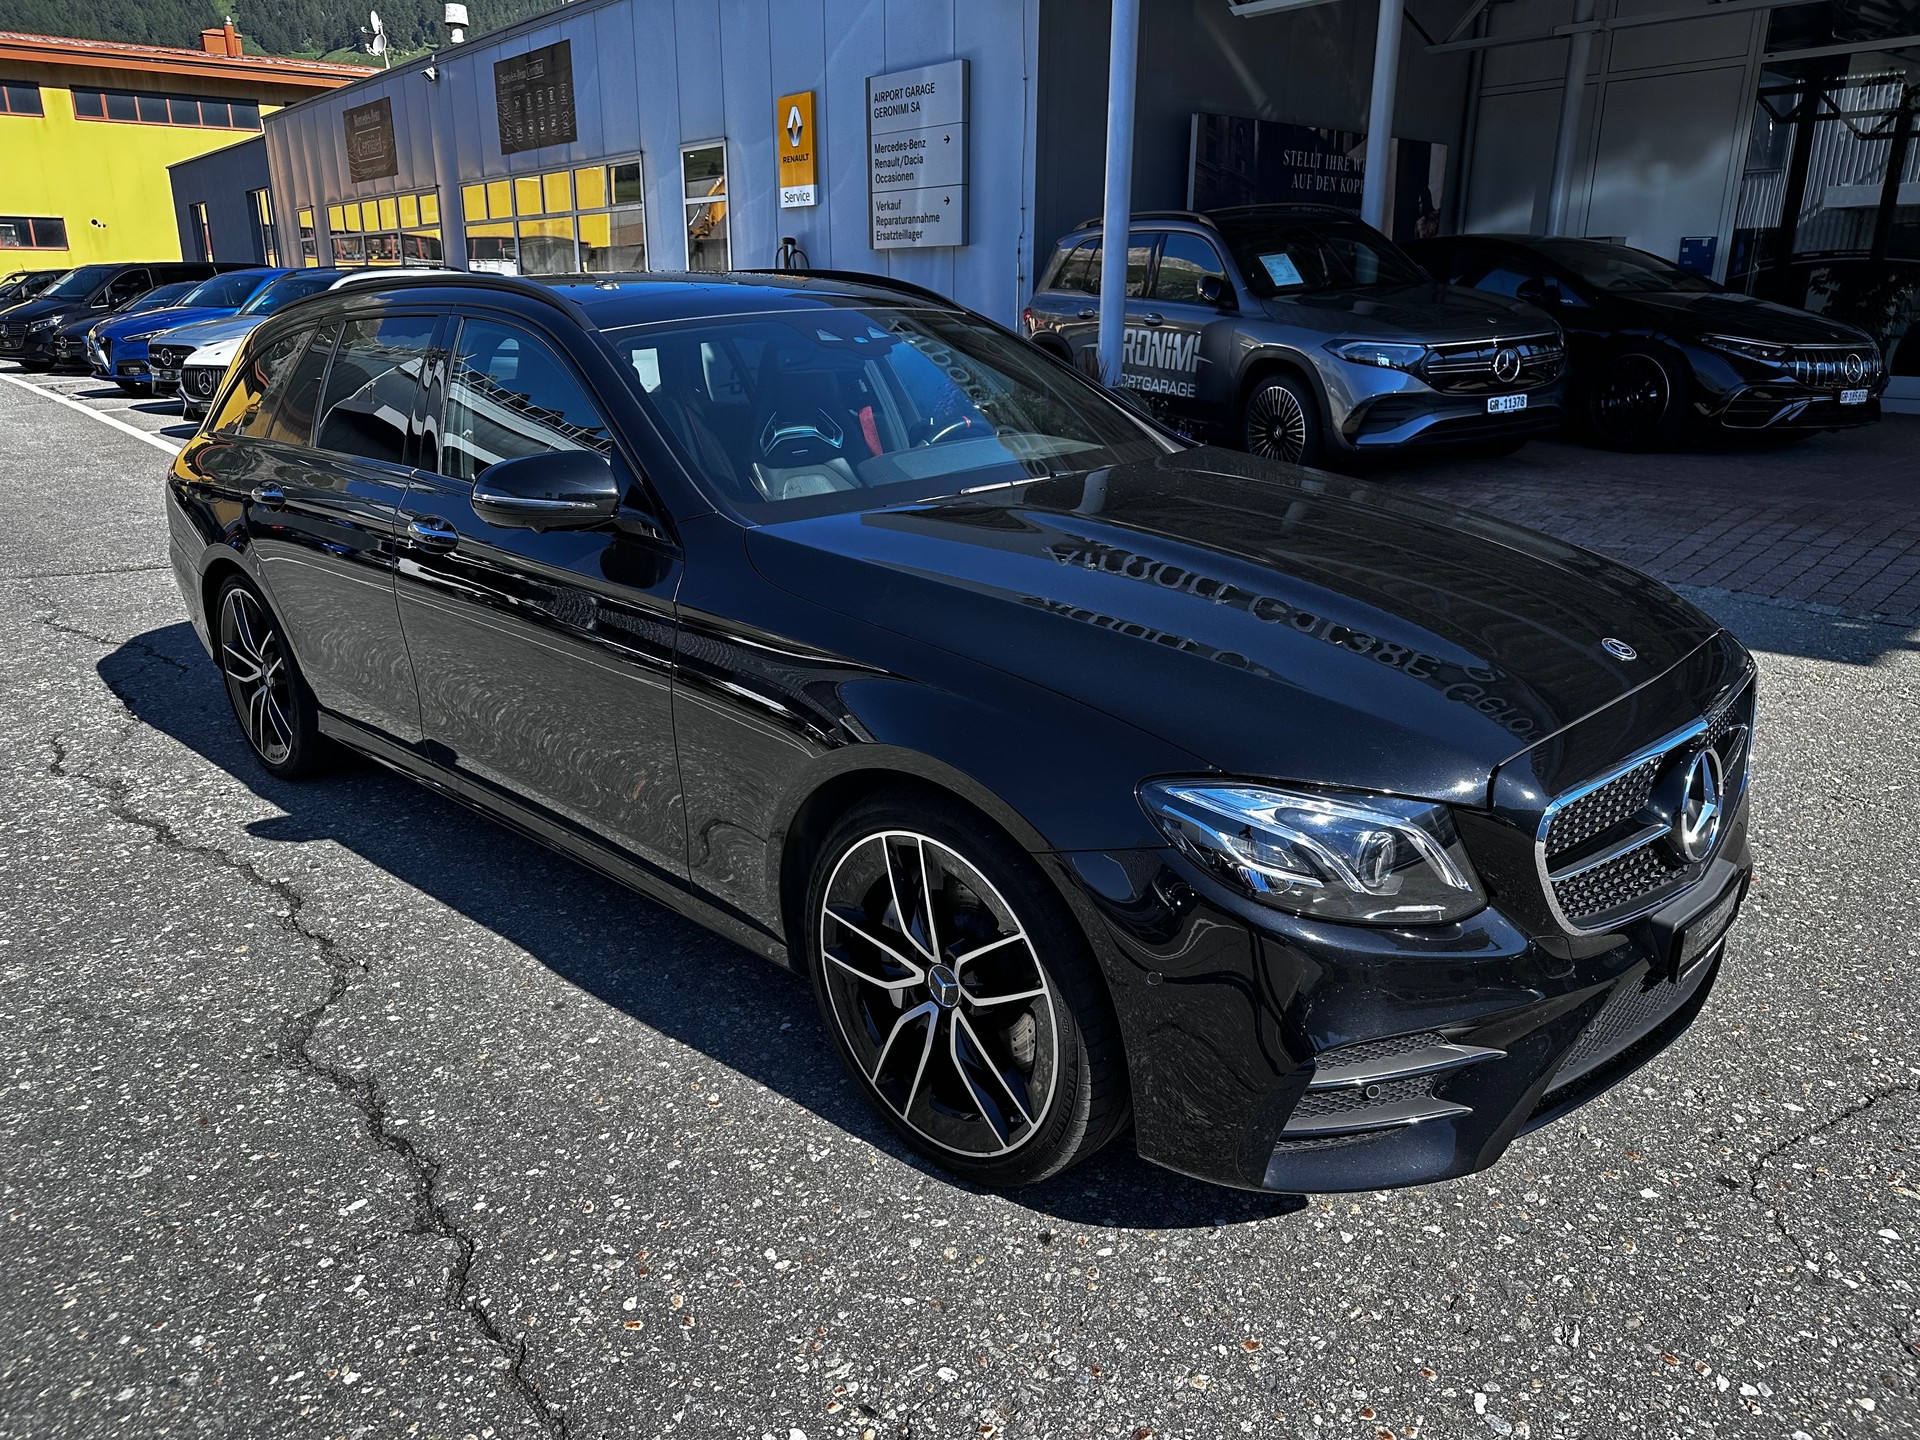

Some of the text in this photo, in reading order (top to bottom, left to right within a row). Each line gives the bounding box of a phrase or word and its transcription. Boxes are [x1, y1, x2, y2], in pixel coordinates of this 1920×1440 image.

[873, 82, 935, 103] AIRPORT GARAGE
[873, 101, 921, 118] GERONIMI SA
[874, 139, 926, 154] Mercedes-Benz
[782, 153, 810, 164] RENAULT
[874, 154, 924, 169] Renault/Dacia
[1283, 149, 1323, 169] STELLT
[1324, 154, 1350, 172] IHRE
[875, 172, 914, 184] Occasionen
[1291, 173, 1313, 190] AUF
[1315, 175, 1337, 192] DEN
[784, 190, 810, 204] Service
[876, 199, 902, 211] Verkauf
[876, 212, 940, 228] Reparaturannahme
[876, 229, 923, 242] Ersatzteillager
